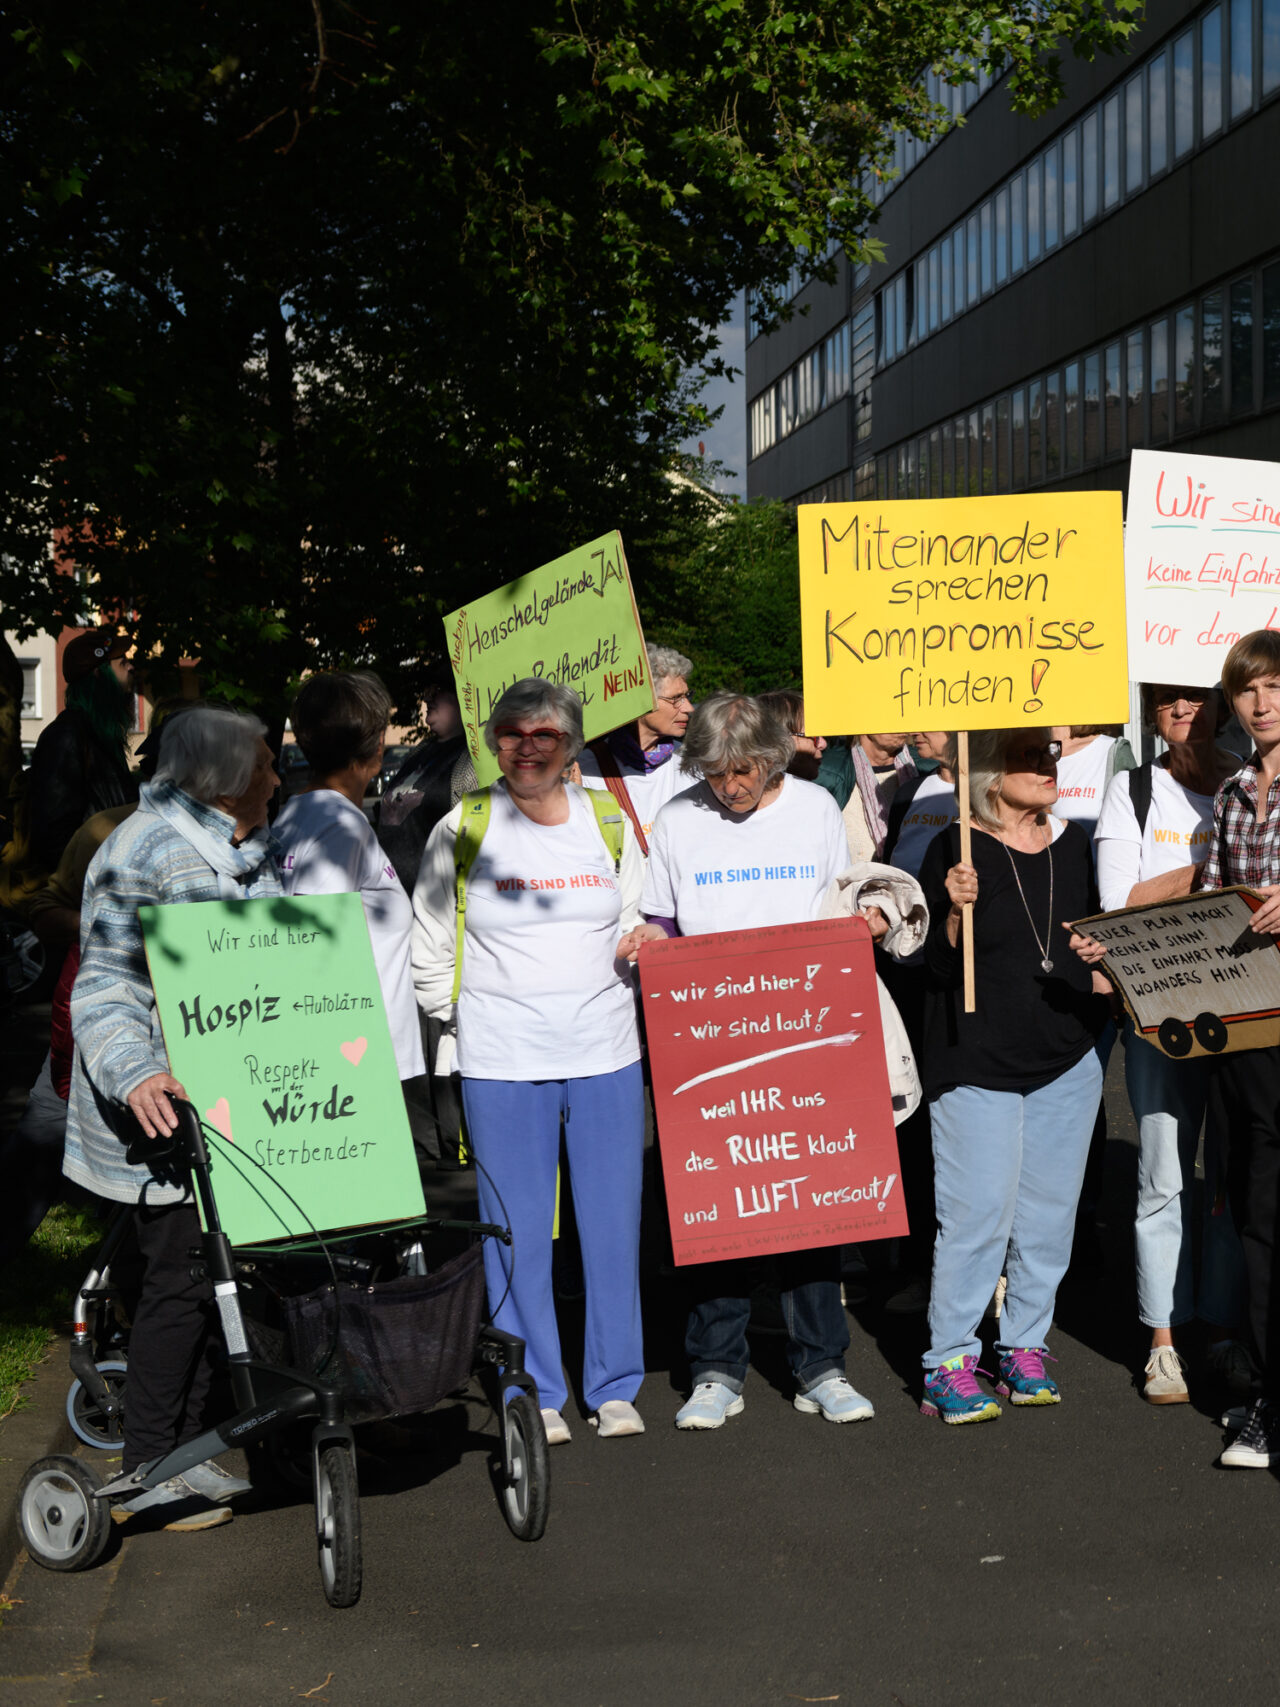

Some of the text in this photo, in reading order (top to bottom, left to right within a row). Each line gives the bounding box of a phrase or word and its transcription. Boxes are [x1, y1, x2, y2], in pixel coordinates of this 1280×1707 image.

[1155, 470, 1216, 520] Wir
[821, 514, 1078, 575] Miteinander
[888, 568, 1049, 615] sprechen
[466, 570, 596, 663] Henschelgelände
[1145, 619, 1183, 647] vor
[1197, 610, 1242, 647] dem
[825, 609, 1105, 669] Kompromisse
[474, 673, 518, 728] LK
[603, 655, 645, 702] NEIN!
[1154, 828, 1181, 845] WIR
[495, 878, 526, 892] WIR
[530, 878, 566, 891] SIND
[695, 870, 723, 886] WIR
[726, 867, 761, 883] SIND
[207, 926, 322, 954] Wir sind hier
[1089, 904, 1234, 943] EUER PLAN MACHT
[1106, 928, 1208, 959] KEINEN SINN!
[1121, 962, 1146, 976] DIE
[1151, 948, 1213, 970] EINFAHRT
[1131, 962, 1250, 997] WOANDERS HIN!
[670, 984, 708, 1003] wir
[713, 975, 756, 999] sind
[177, 983, 281, 1039] Hospiz
[689, 1020, 722, 1041] wir
[728, 1015, 770, 1038] sind
[244, 1054, 320, 1090] Respekt
[262, 1084, 358, 1128] Würde
[700, 1086, 826, 1121] weil IHR uns
[253, 1136, 377, 1168] Sterbender
[684, 1127, 858, 1173] die RUHE klaut
[683, 1202, 719, 1225] und
[734, 1174, 811, 1219] LUFT
